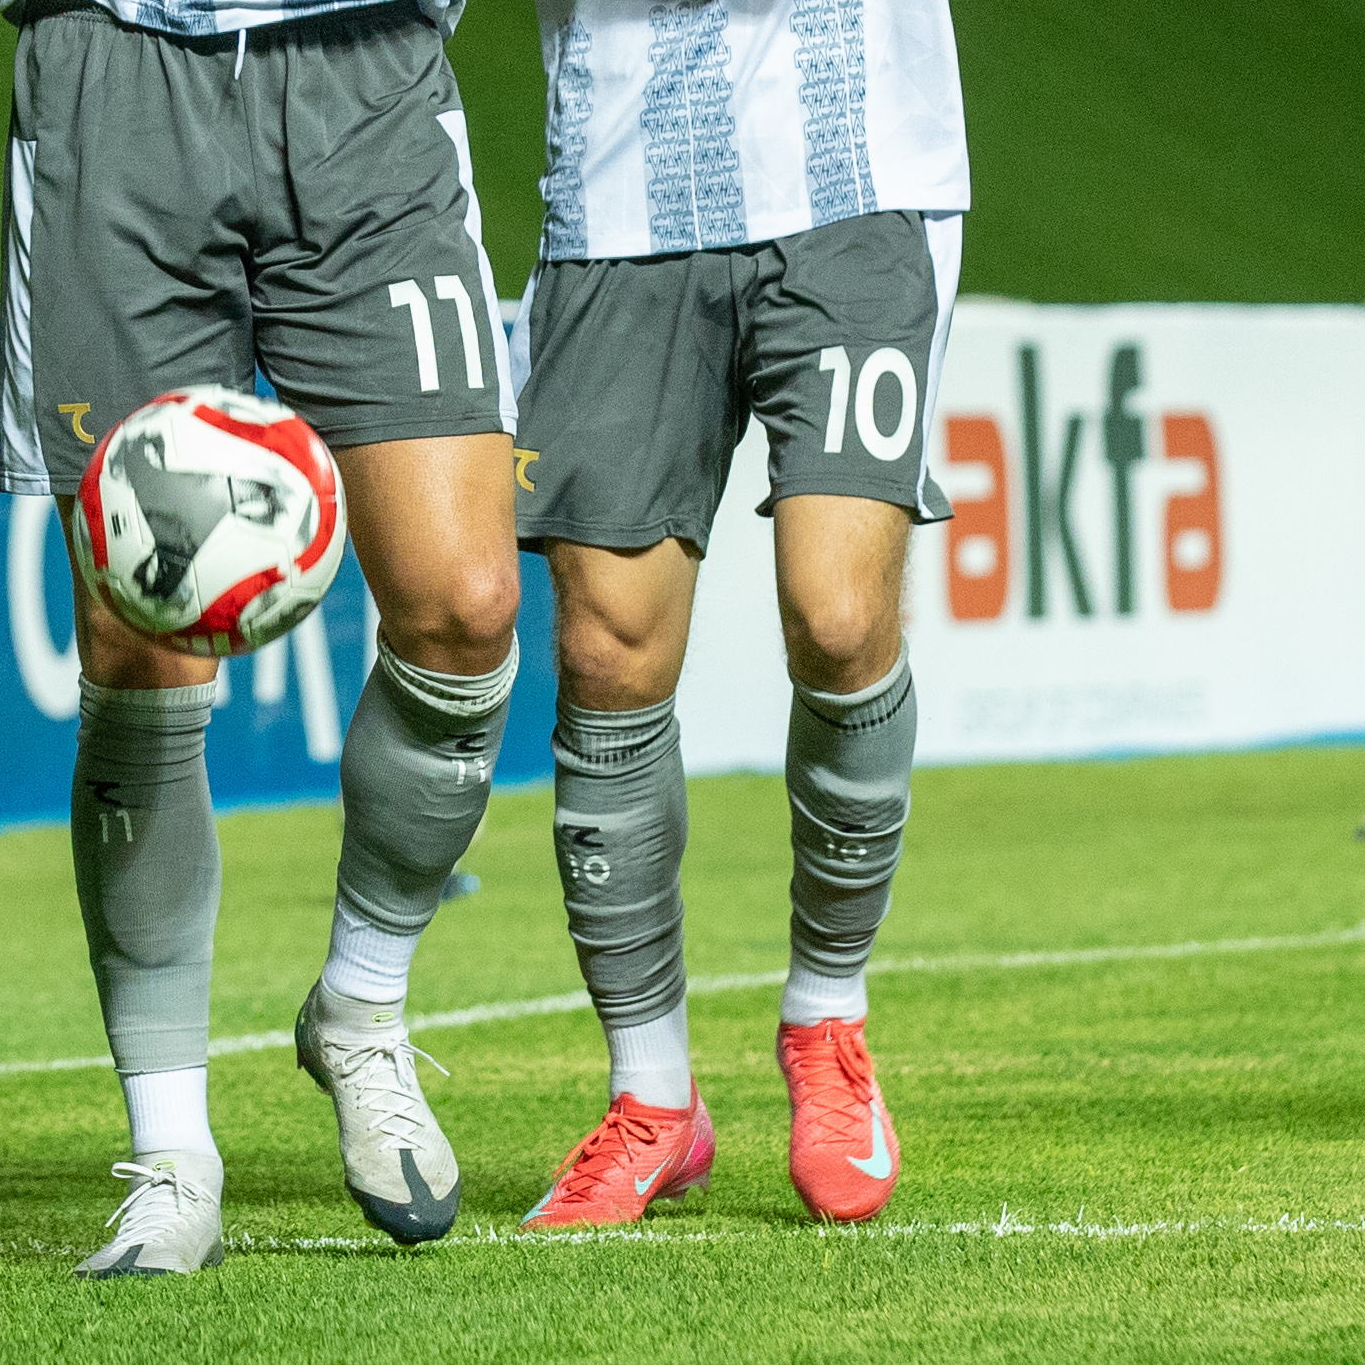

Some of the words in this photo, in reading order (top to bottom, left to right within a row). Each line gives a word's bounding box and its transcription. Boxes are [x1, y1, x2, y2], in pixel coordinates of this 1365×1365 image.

[389, 274, 485, 392] 11
[819, 345, 917, 461] 10
[943, 339, 1224, 621] akfa
[99, 809, 133, 843] 11
